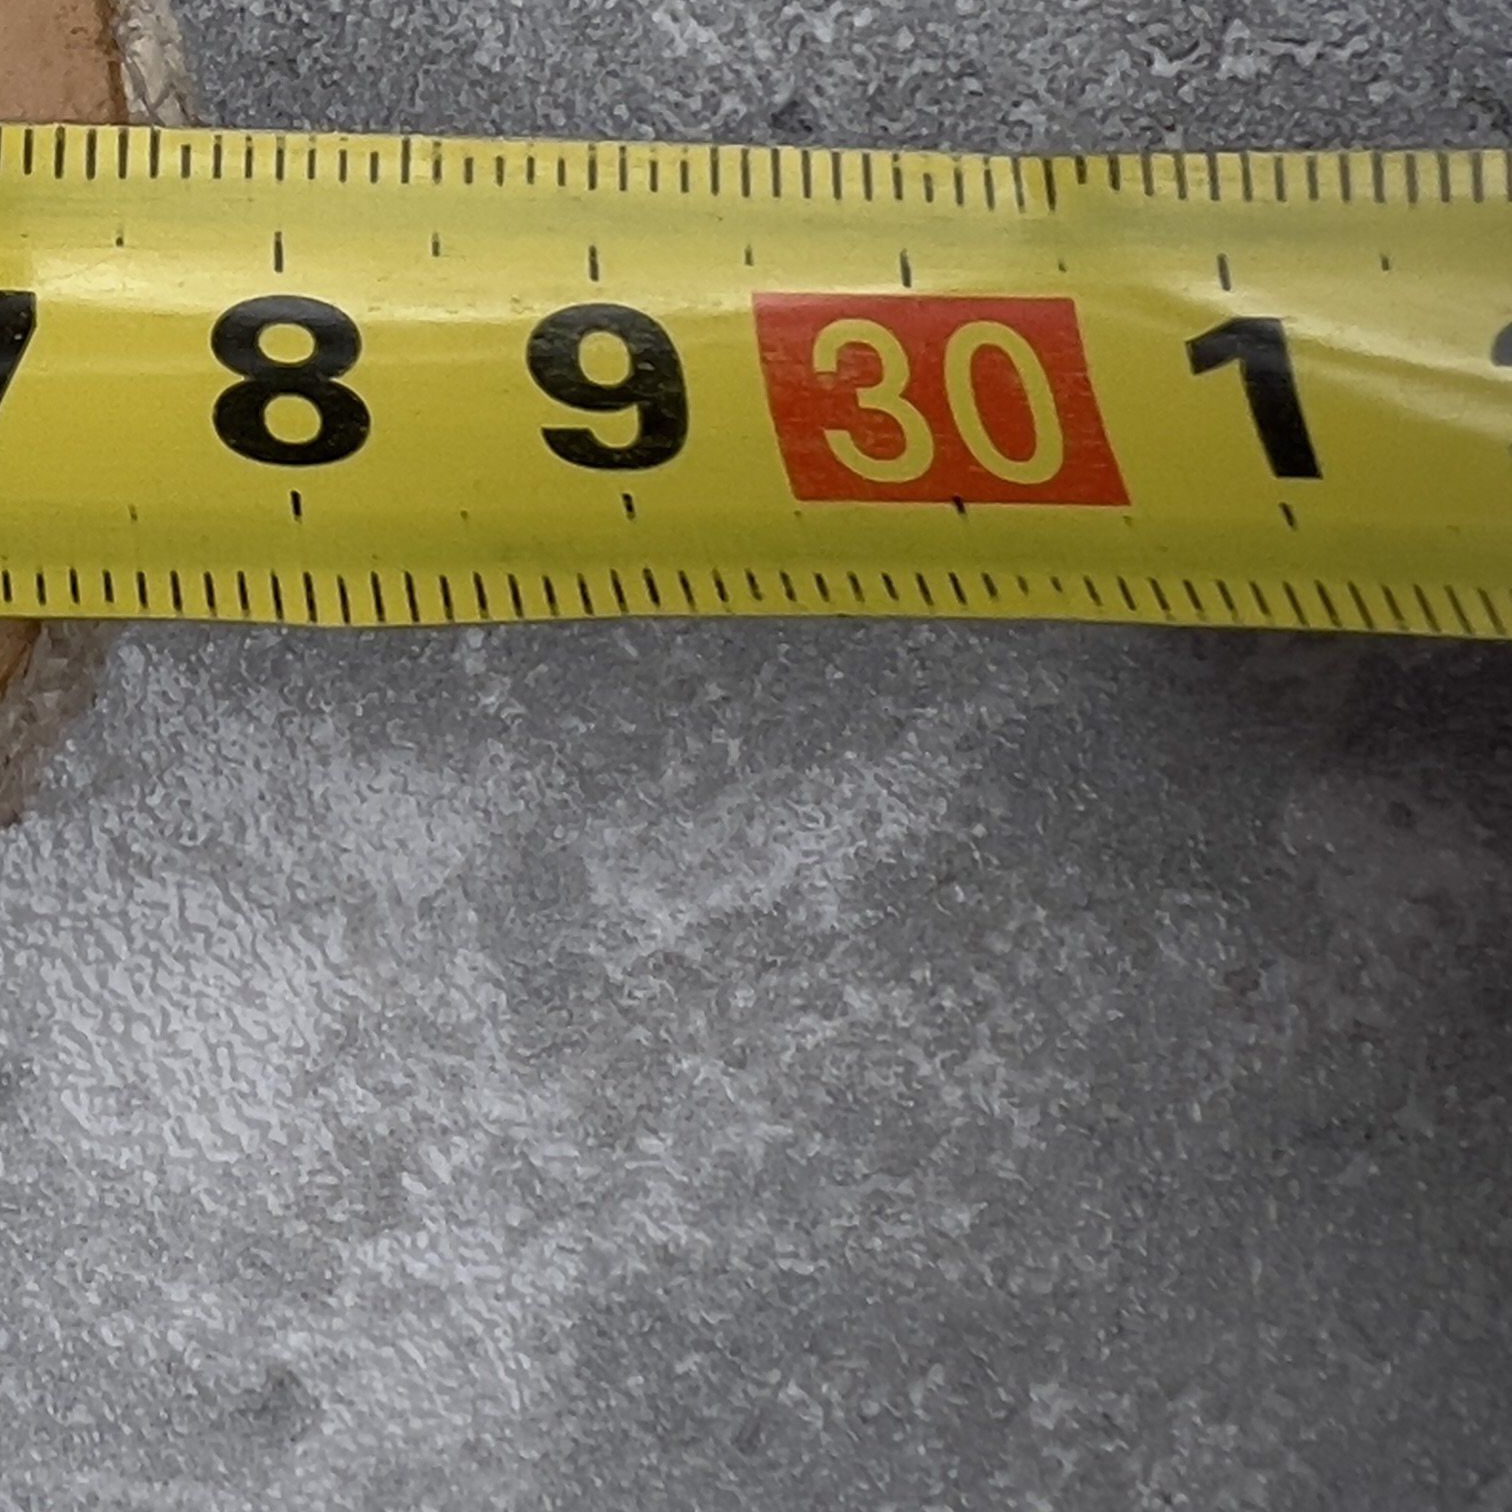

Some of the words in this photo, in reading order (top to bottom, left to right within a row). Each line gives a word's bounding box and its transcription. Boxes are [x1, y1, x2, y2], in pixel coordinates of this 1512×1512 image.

[211, 297, 371, 466] 8
[526, 304, 689, 471] 9
[812, 319, 1063, 483] 30
[1185, 317, 1324, 480] 1
